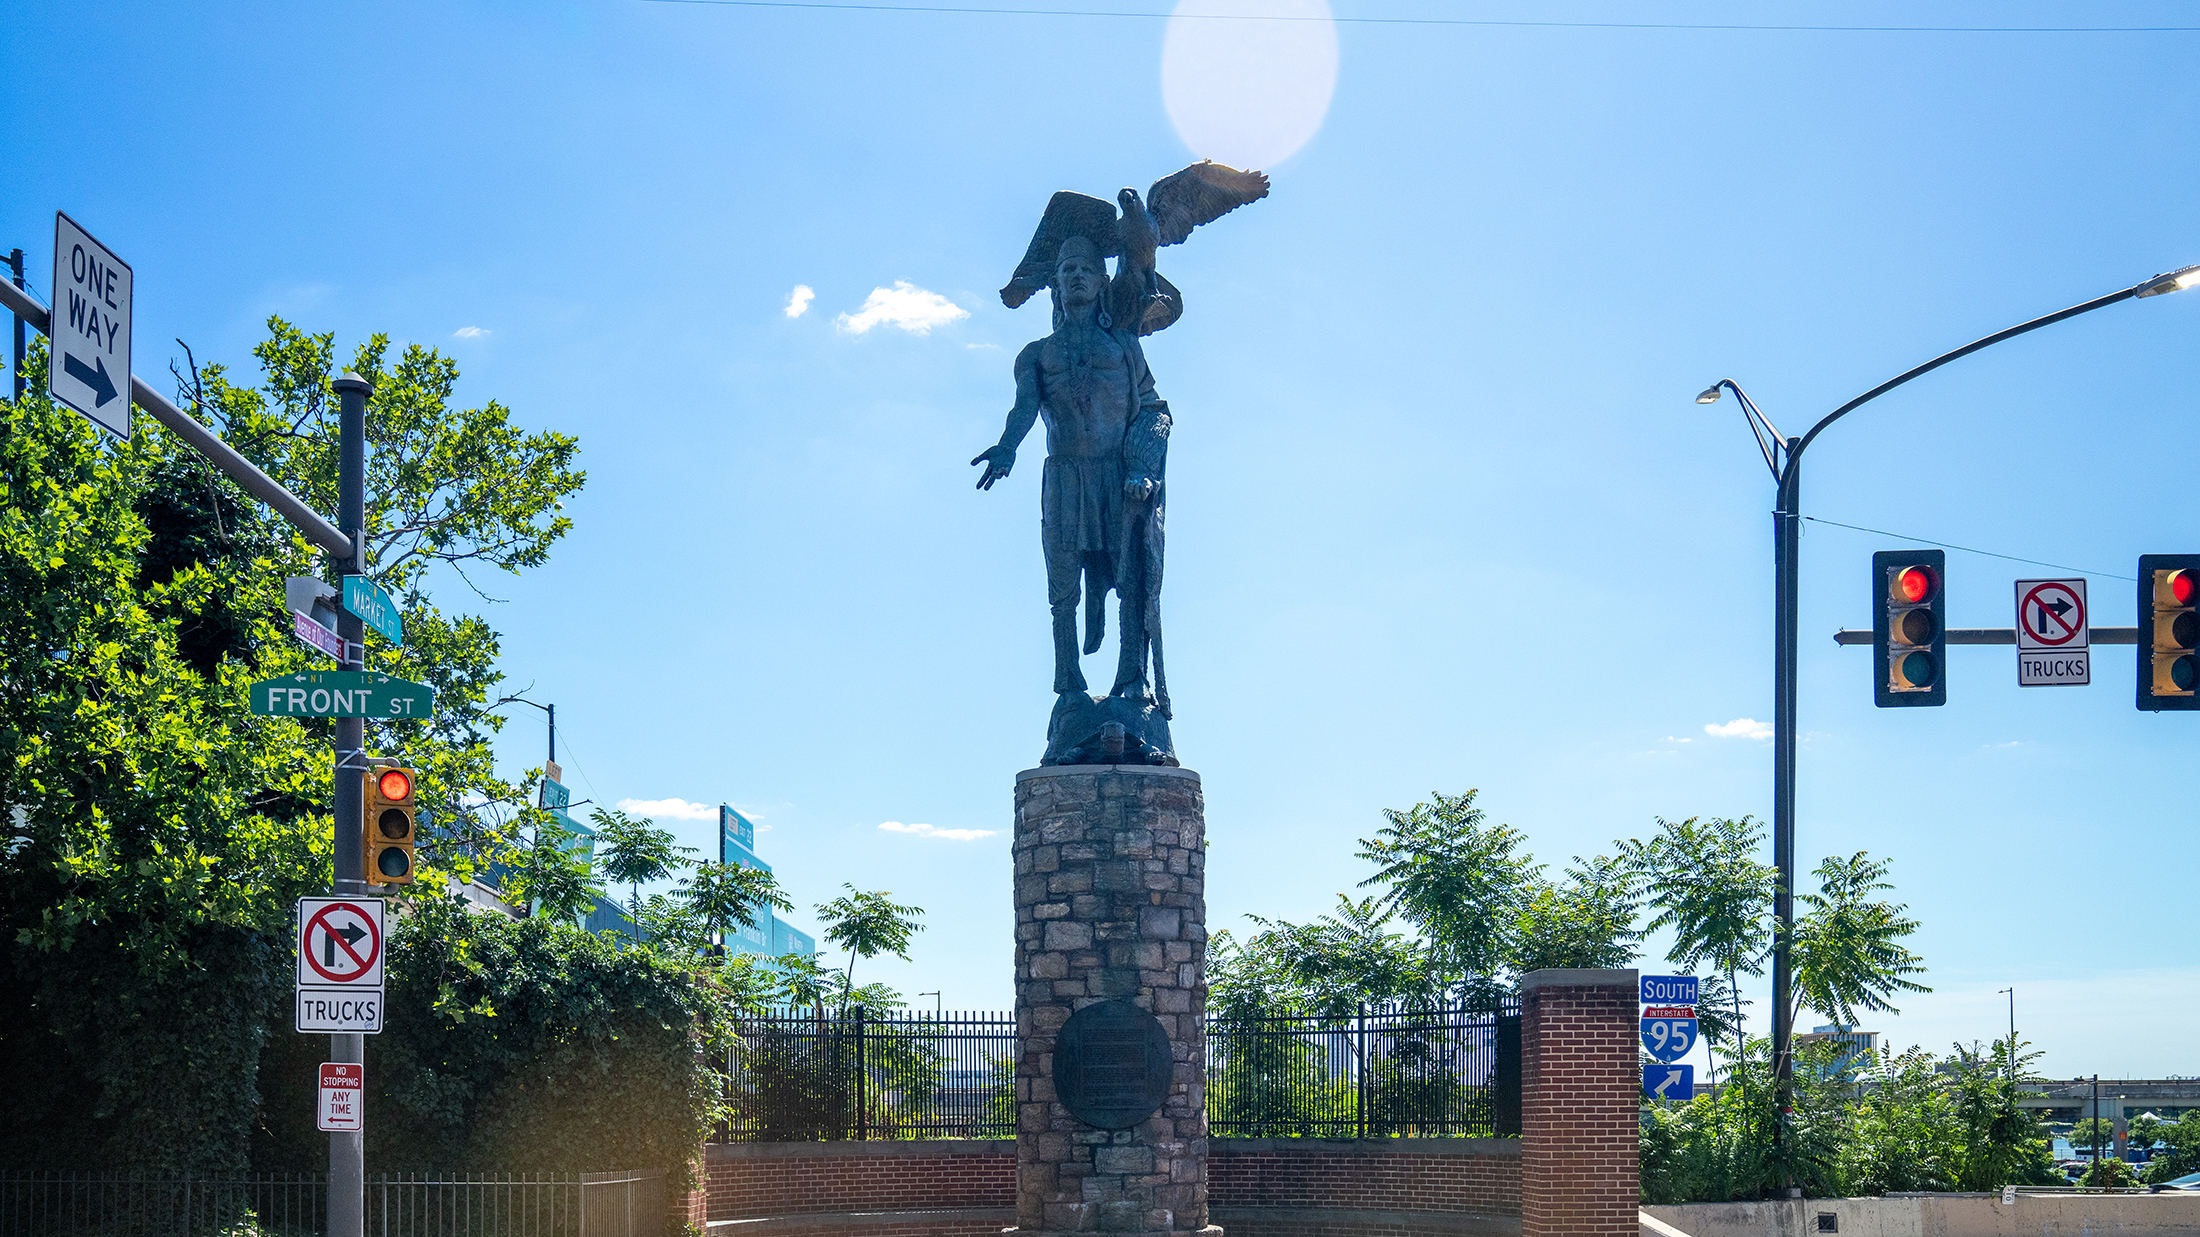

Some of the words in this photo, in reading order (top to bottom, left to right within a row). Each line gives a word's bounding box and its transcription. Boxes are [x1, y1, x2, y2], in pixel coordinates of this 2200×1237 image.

[71, 243, 118, 311] ONE
[68, 287, 119, 355] WAY
[353, 586, 386, 631] MARKET
[388, 620, 395, 638] ST
[2024, 660, 2085, 677] TRUCKS
[310, 675, 316, 683] N
[367, 675, 373, 684] S
[268, 687, 373, 714] FRONT
[389, 698, 415, 715] ST
[548, 762, 561, 781] LEFT
[560, 791, 567, 806] 22
[1644, 980, 1695, 1000] SOUTH
[304, 1000, 376, 1021] TRUCKS
[1650, 1021, 1689, 1052] 95
[335, 1067, 347, 1076] NO
[323, 1077, 359, 1087] STOPPING
[331, 1091, 351, 1102] ANY
[330, 1104, 352, 1115] TIME
